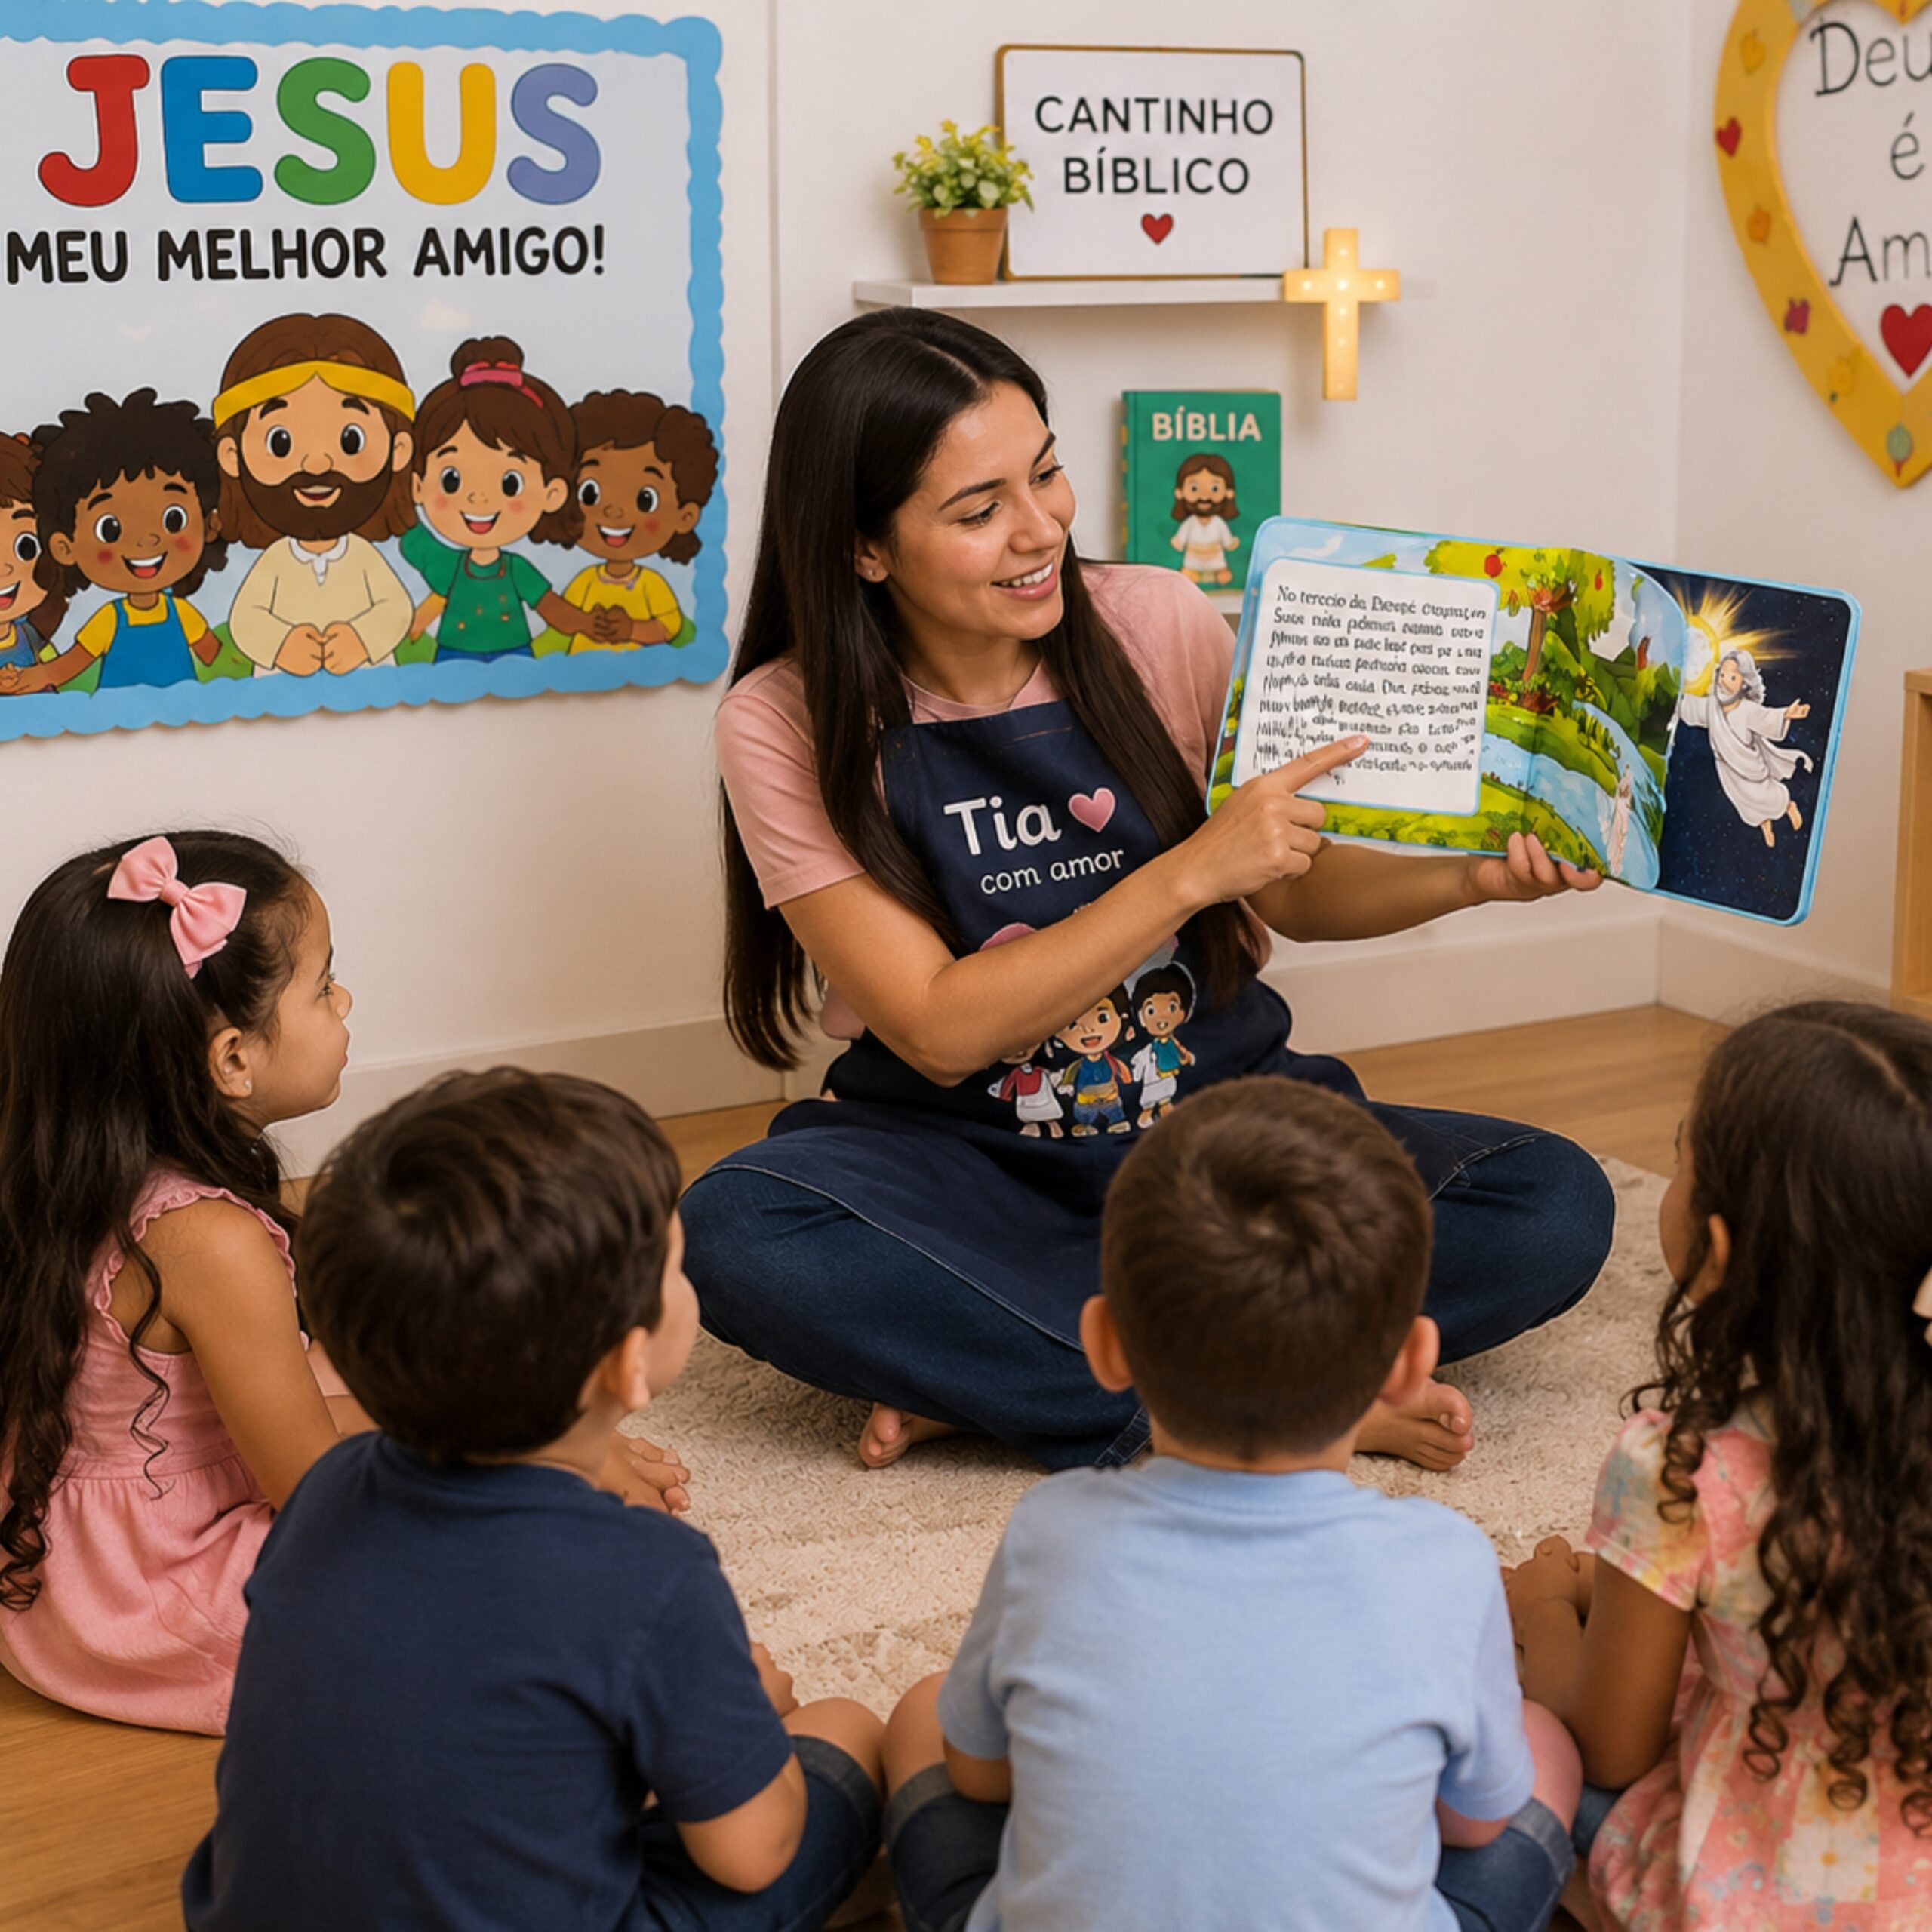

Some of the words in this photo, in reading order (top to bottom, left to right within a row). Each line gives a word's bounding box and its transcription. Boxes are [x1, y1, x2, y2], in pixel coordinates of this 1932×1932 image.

[1809, 21, 1932, 97] Deu
[38, 54, 601, 208] JESUS
[1035, 96, 1275, 135] CANTINHO
[1890, 111, 1925, 180] é
[1063, 146, 1250, 195] BÍBLICO
[6, 229, 129, 285] MEU
[158, 227, 388, 281] MELHOR
[413, 224, 606, 277] AMIGO!
[1829, 216, 1932, 288] Am
[1152, 405, 1263, 442] BÍBLIA
[943, 795, 1062, 856] Tia
[980, 865, 1042, 894] com
[1049, 848, 1124, 882] amor
